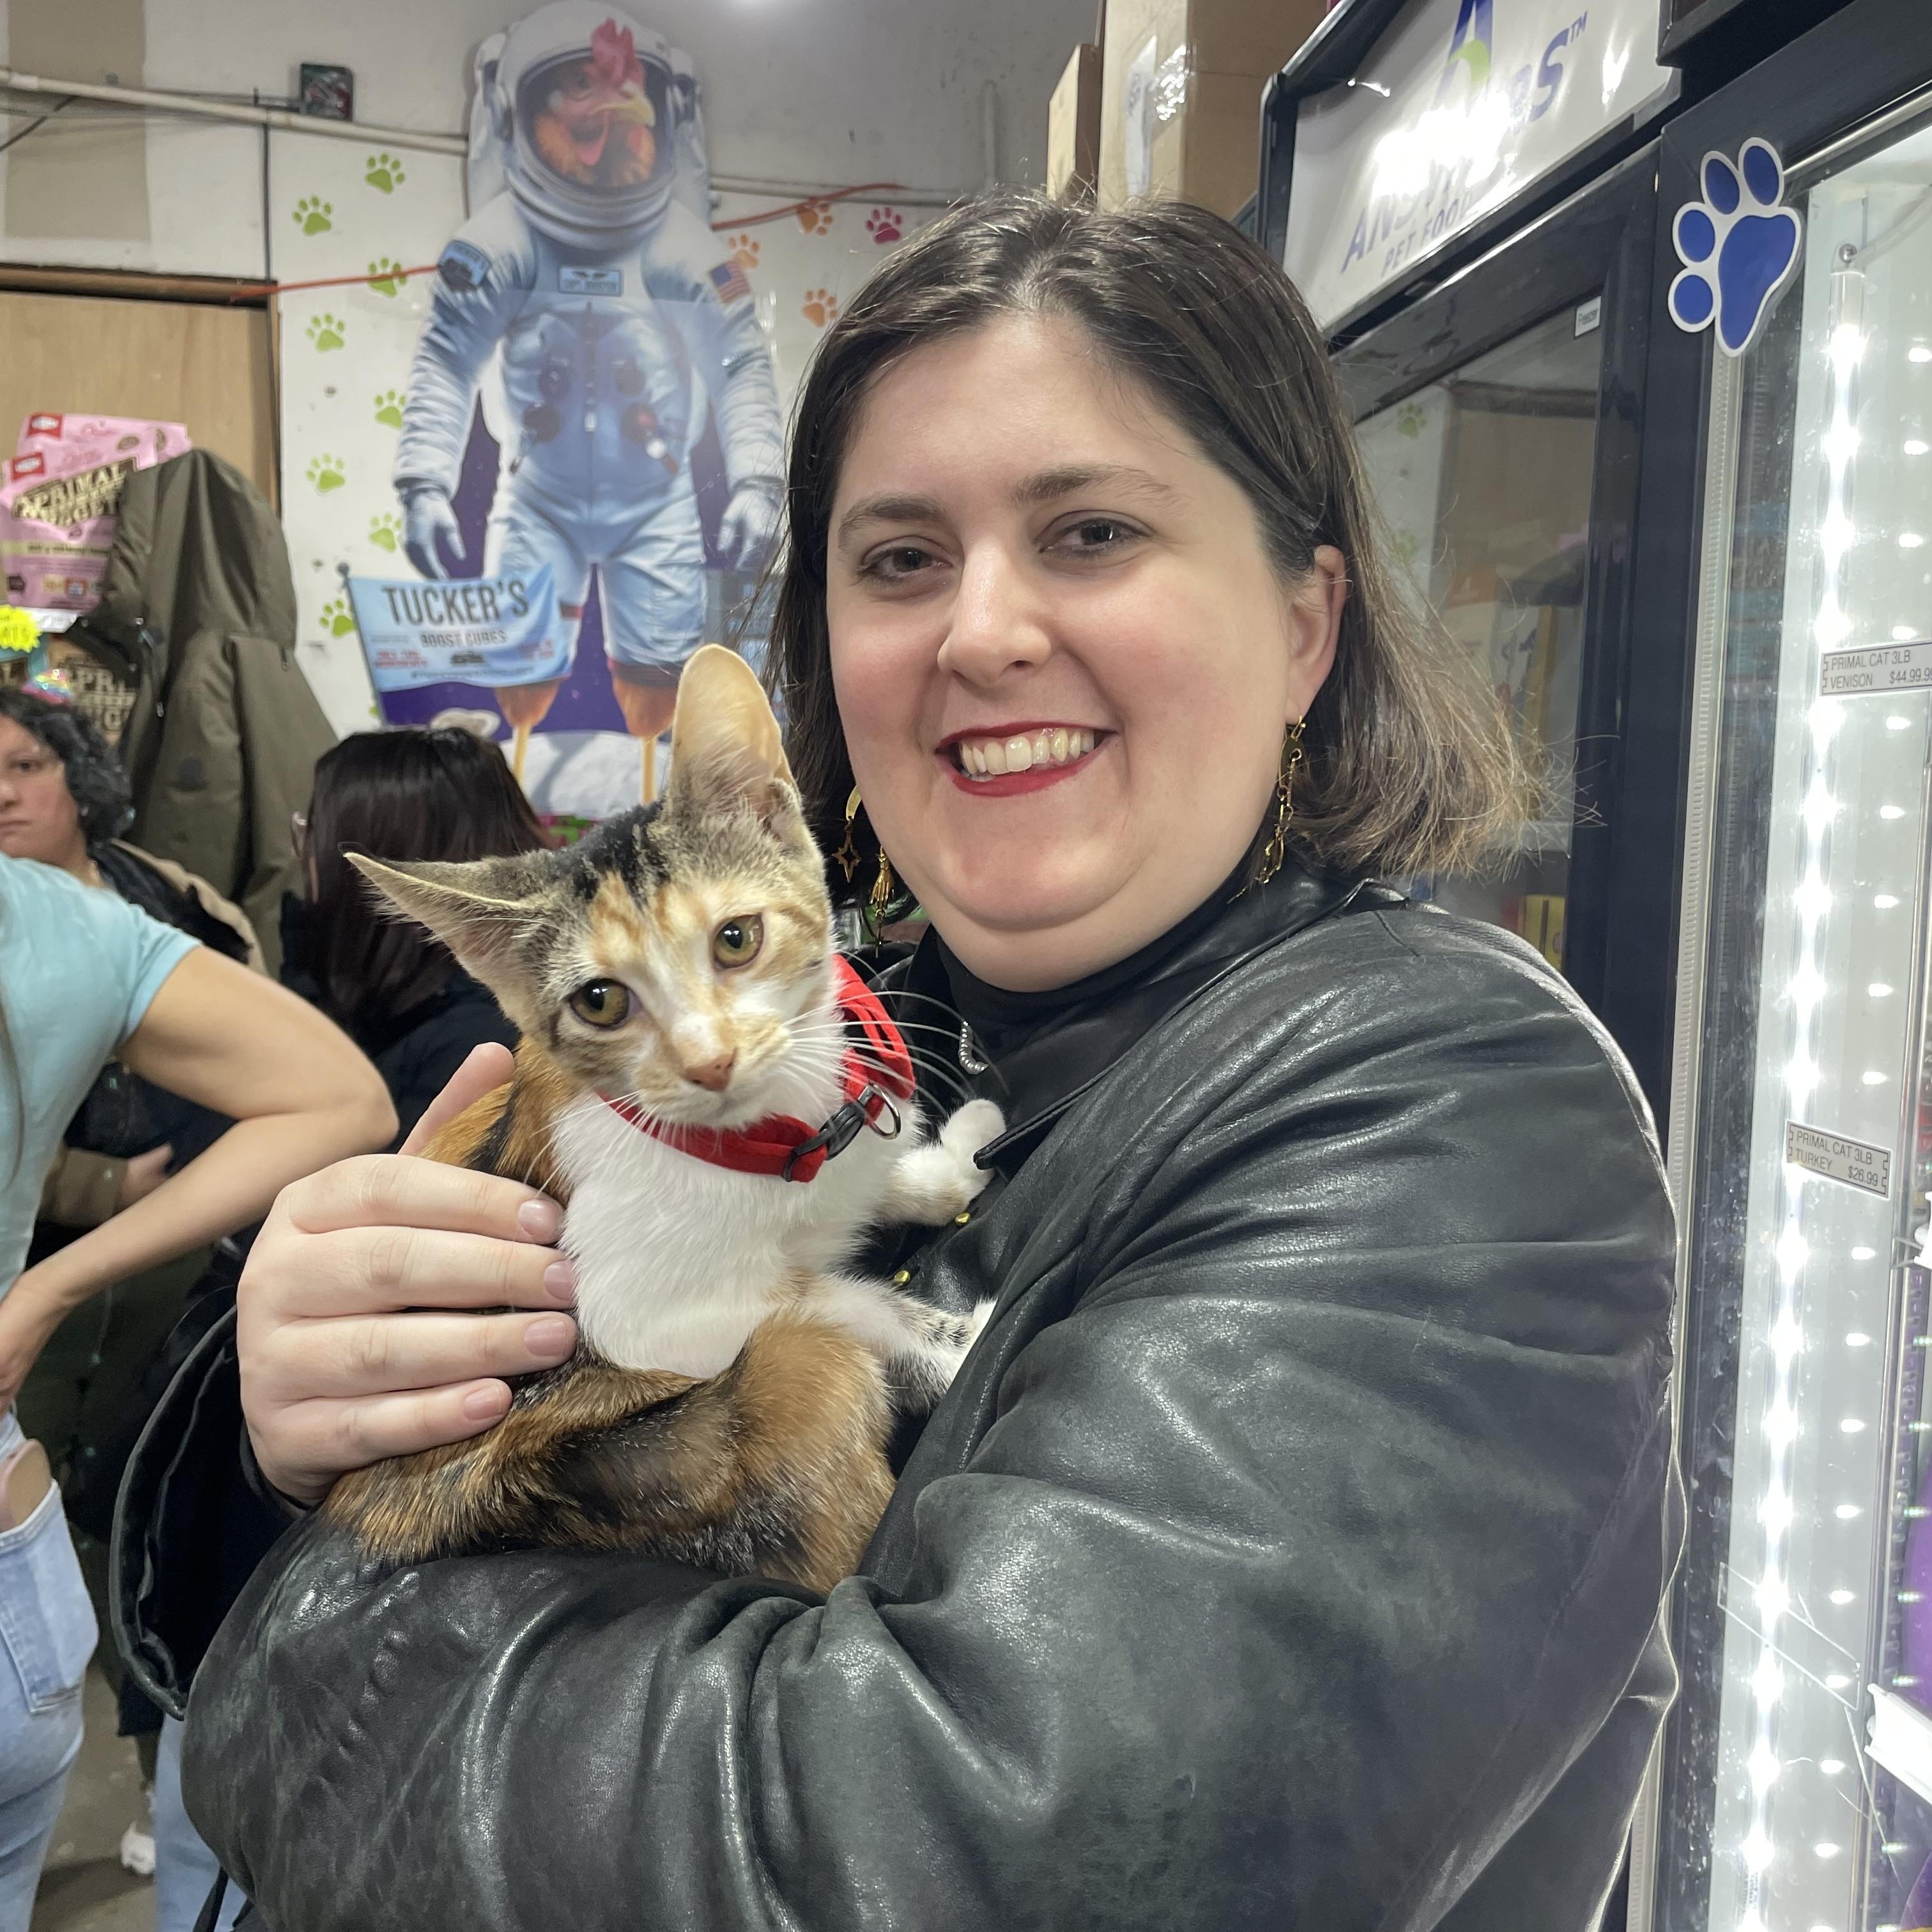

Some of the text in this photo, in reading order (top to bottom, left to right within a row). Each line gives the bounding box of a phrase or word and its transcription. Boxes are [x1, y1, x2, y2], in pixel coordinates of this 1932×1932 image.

[1381, 230, 1416, 279] PET
[382, 578, 529, 626] TUCKER'S
[420, 633, 461, 648] BOOST
[1831, 649, 1910, 671] PRIMAL CAT 3LB
[1830, 673, 1873, 689] VENISON
[1797, 1130, 1872, 1165] PRIMAL CAT 3LB
[1796, 1148, 1878, 1187] TURKEY $26.99
